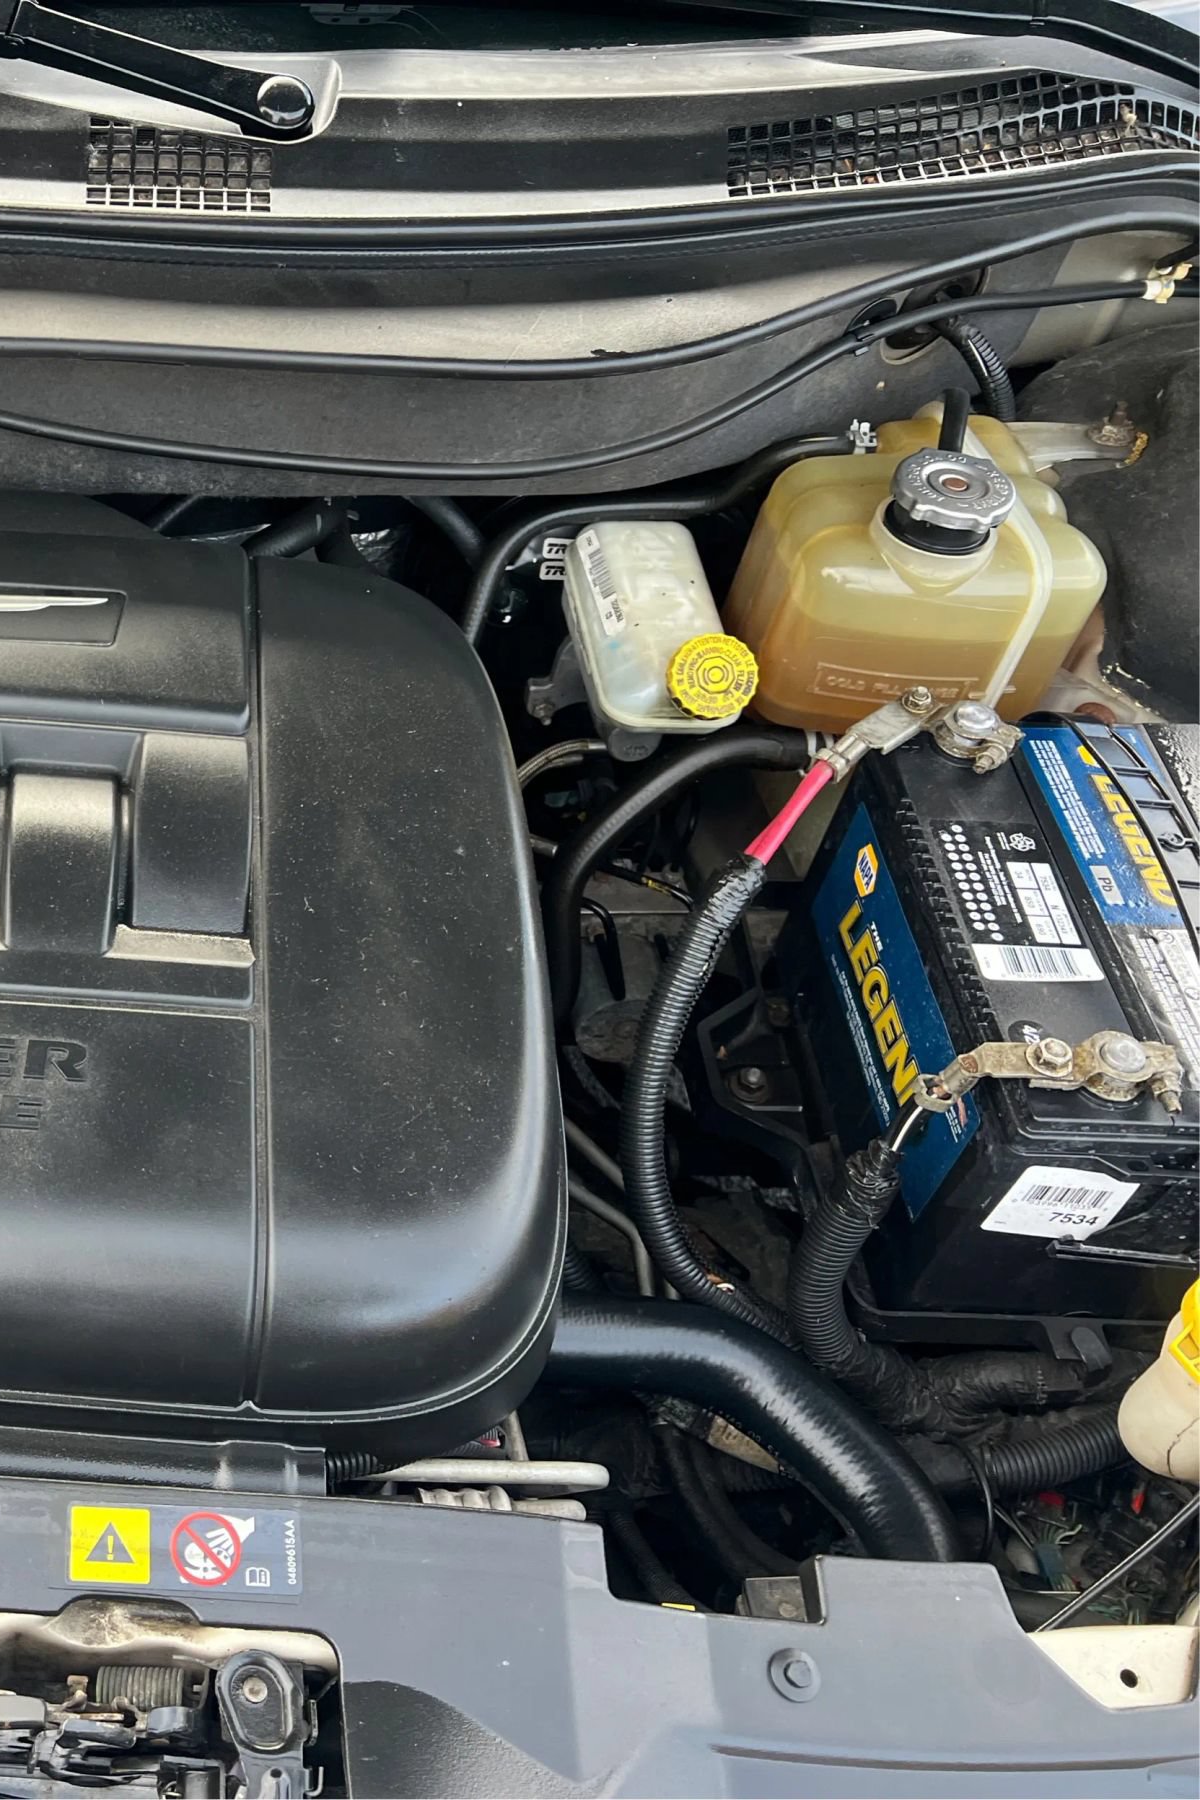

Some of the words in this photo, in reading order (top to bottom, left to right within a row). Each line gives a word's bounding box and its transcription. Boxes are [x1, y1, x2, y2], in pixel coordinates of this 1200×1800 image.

[858, 851, 874, 890] NAPA
[1098, 876, 1113, 893] Pb
[871, 920, 884, 952] THE
[838, 896, 921, 1108] LEGEN
[1049, 1211, 1100, 1226] 7534
